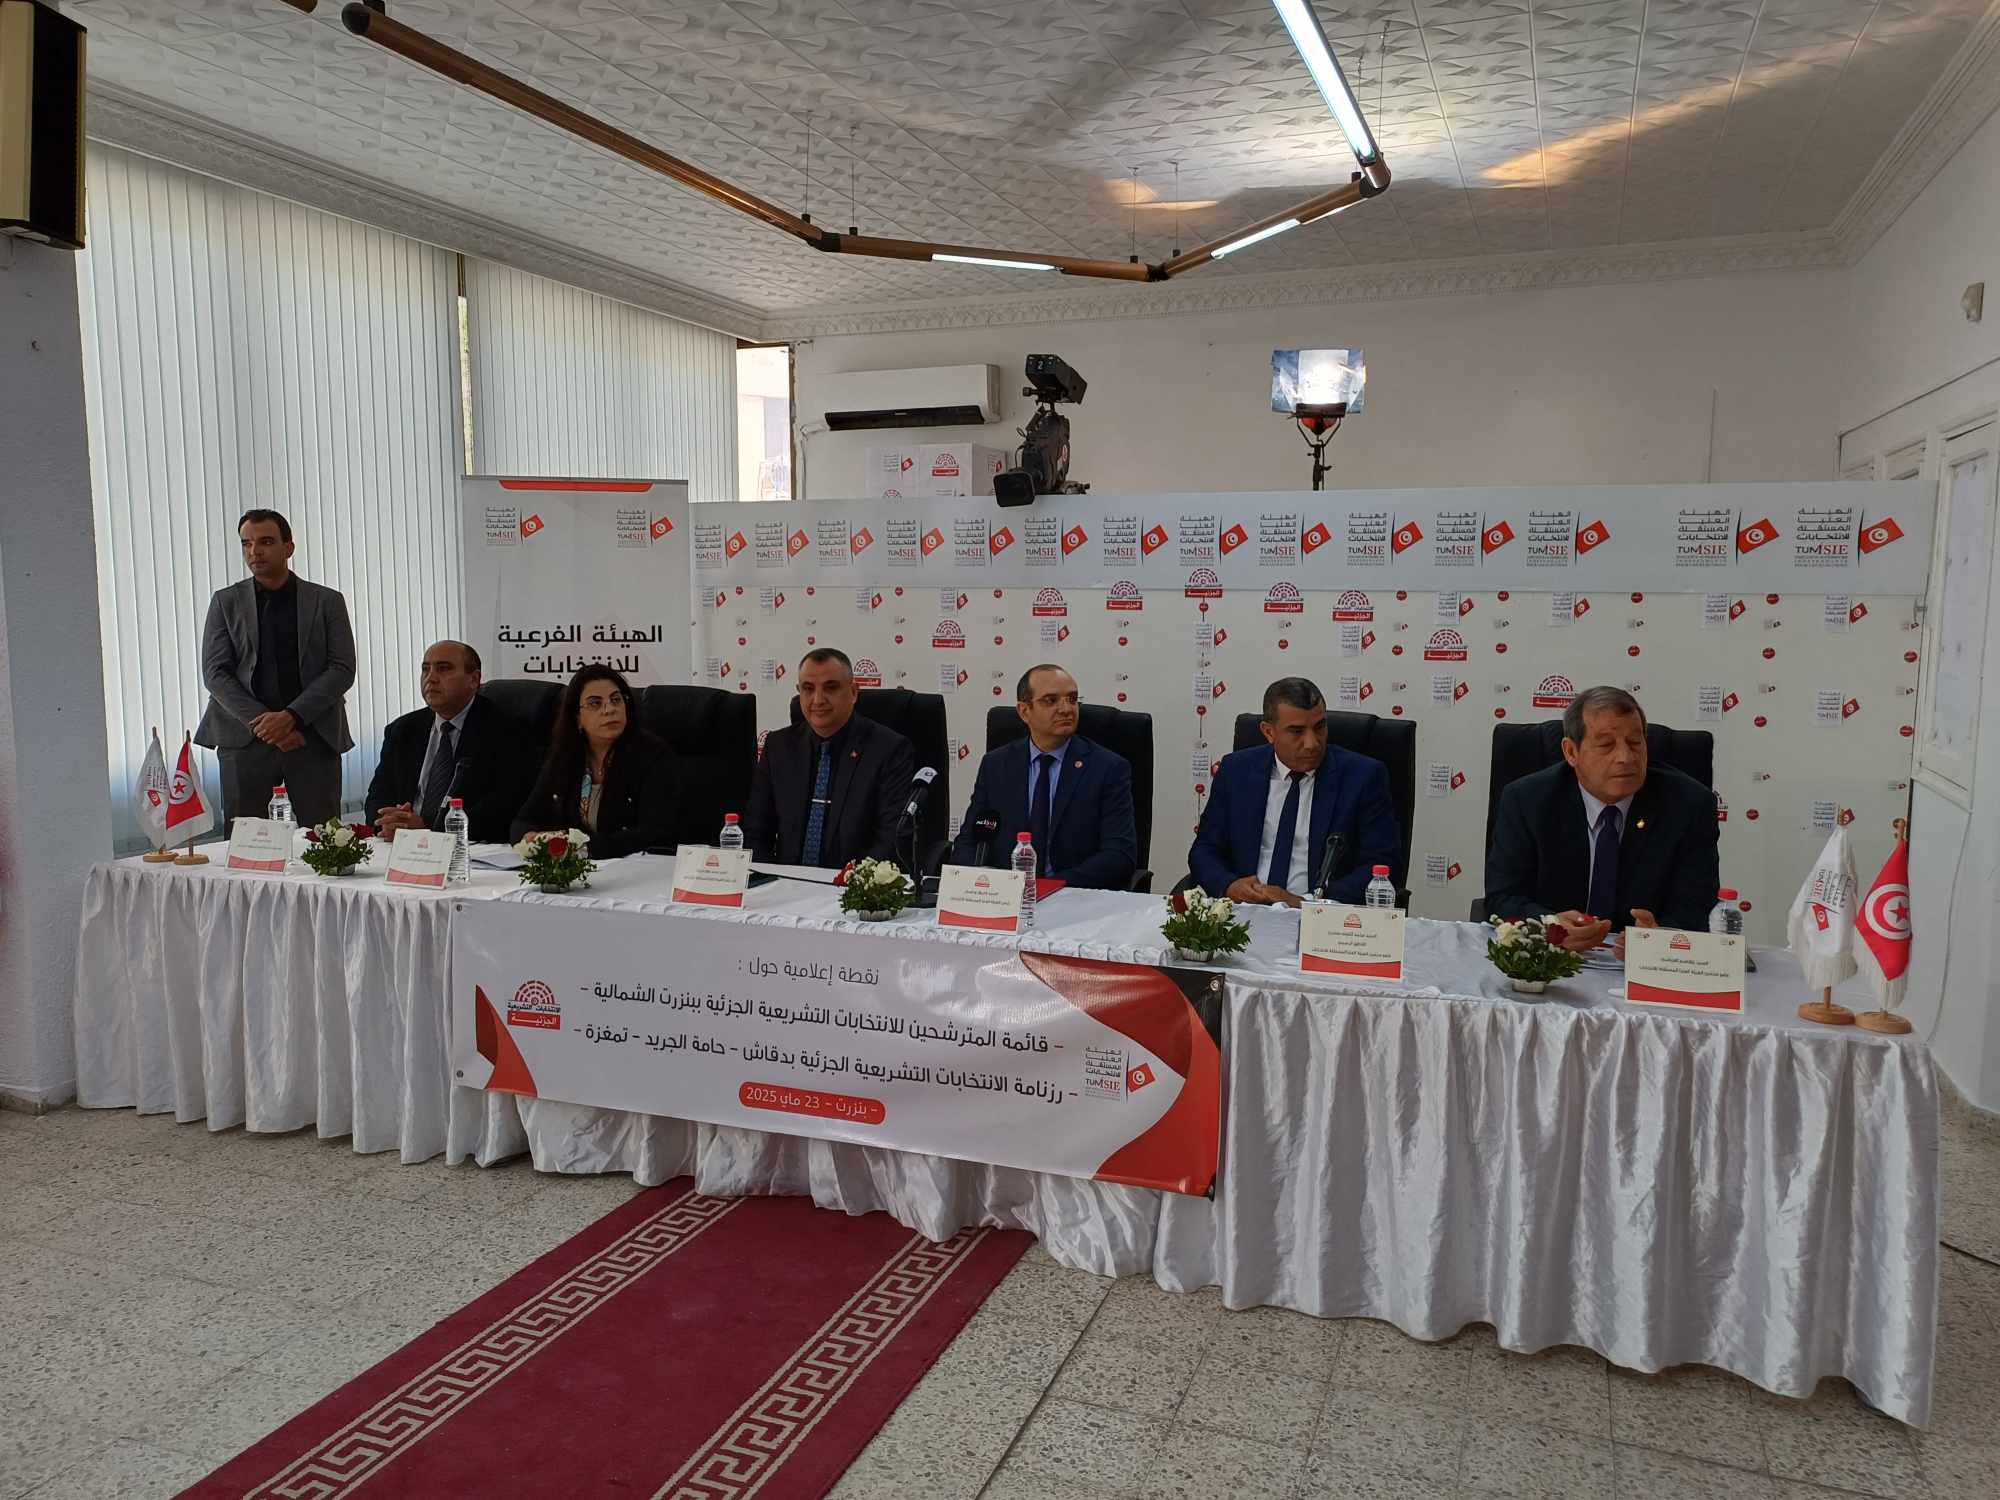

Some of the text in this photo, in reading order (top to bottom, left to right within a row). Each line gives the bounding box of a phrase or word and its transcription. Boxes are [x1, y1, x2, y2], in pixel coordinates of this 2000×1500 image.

[1038, 360, 1044, 370] 2
[1436, 545, 1474, 555] TUNISIE
[1528, 545, 1568, 555] TUNISIE
[1677, 545, 1727, 555] TUNISIE
[1796, 544, 1848, 555] TUNISIE
[498, 624, 662, 648] الهيئة الفرعية
[749, 956, 778, 976] حول
[784, 960, 832, 986] إعلامية
[838, 967, 880, 986] نقطة
[594, 982, 655, 1004] الشمالية
[659, 988, 701, 1014] ببنزرت
[706, 992, 753, 1018] الجزئية
[758, 1002, 830, 1025] التشريعية
[834, 1008, 904, 1034] للانتخابات
[585, 1024, 629, 1043] تمغزة
[645, 1032, 687, 1053] الجريد
[909, 1020, 996, 1048] المترشحين
[1002, 1031, 1049, 1054] قائمة
[692, 1034, 726, 1055] حامة
[743, 1041, 796, 1069] بدقاش
[800, 1049, 849, 1076] الجزئية
[854, 1056, 931, 1083] التشريعية
[936, 1066, 1008, 1092] الانتخابات
[1086, 1078, 1120, 1090] TUNISIE
[746, 1088, 777, 1102] 2025
[780, 1093, 801, 1108] ماي
[1014, 1076, 1063, 1104] رزنامة
[804, 1096, 820, 1109] 23
[835, 1102, 868, 1119] بنزرت
